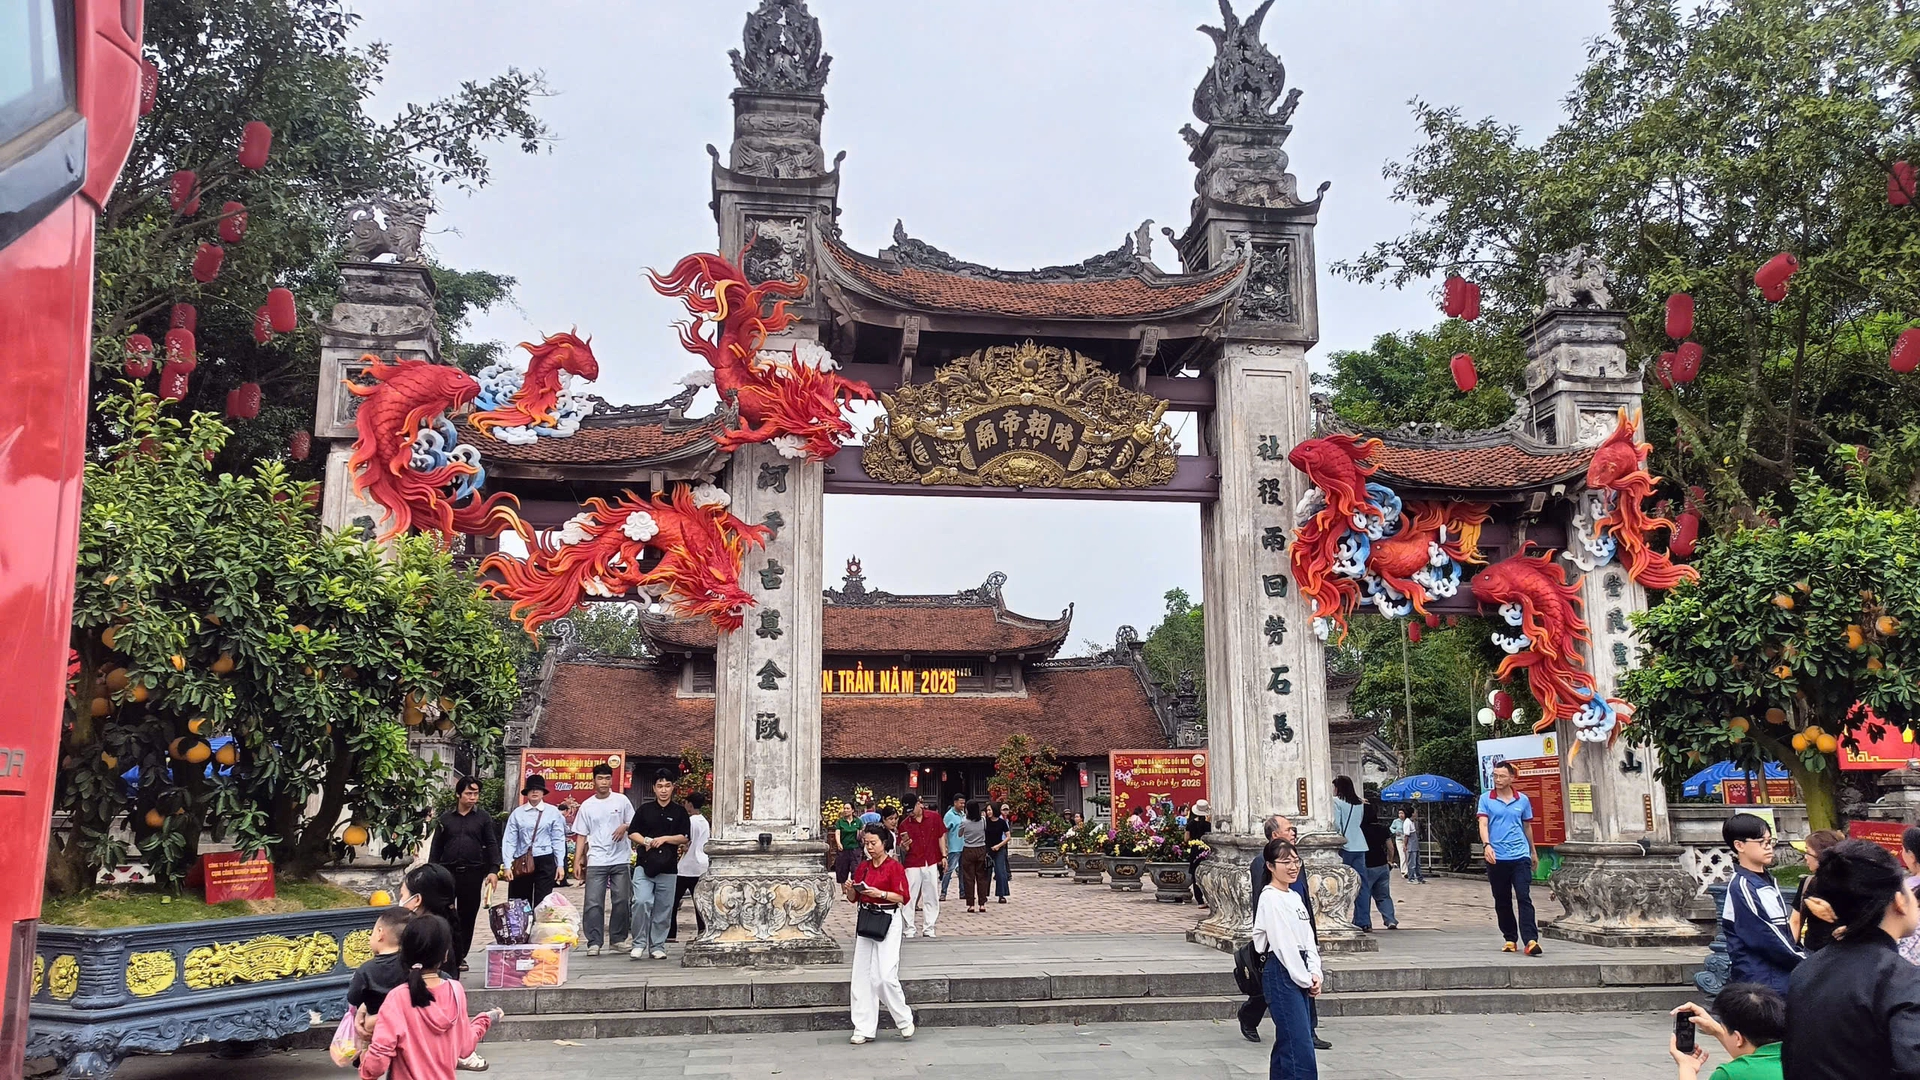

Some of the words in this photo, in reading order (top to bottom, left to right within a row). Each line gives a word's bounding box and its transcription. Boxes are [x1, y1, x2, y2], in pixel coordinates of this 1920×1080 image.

[838, 661, 874, 693] TRẦN
[880, 666, 914, 693] NĂM
[921, 670, 956, 694] 2026
[574, 781, 594, 790] 2026
[1181, 778, 1201, 787] 2026
